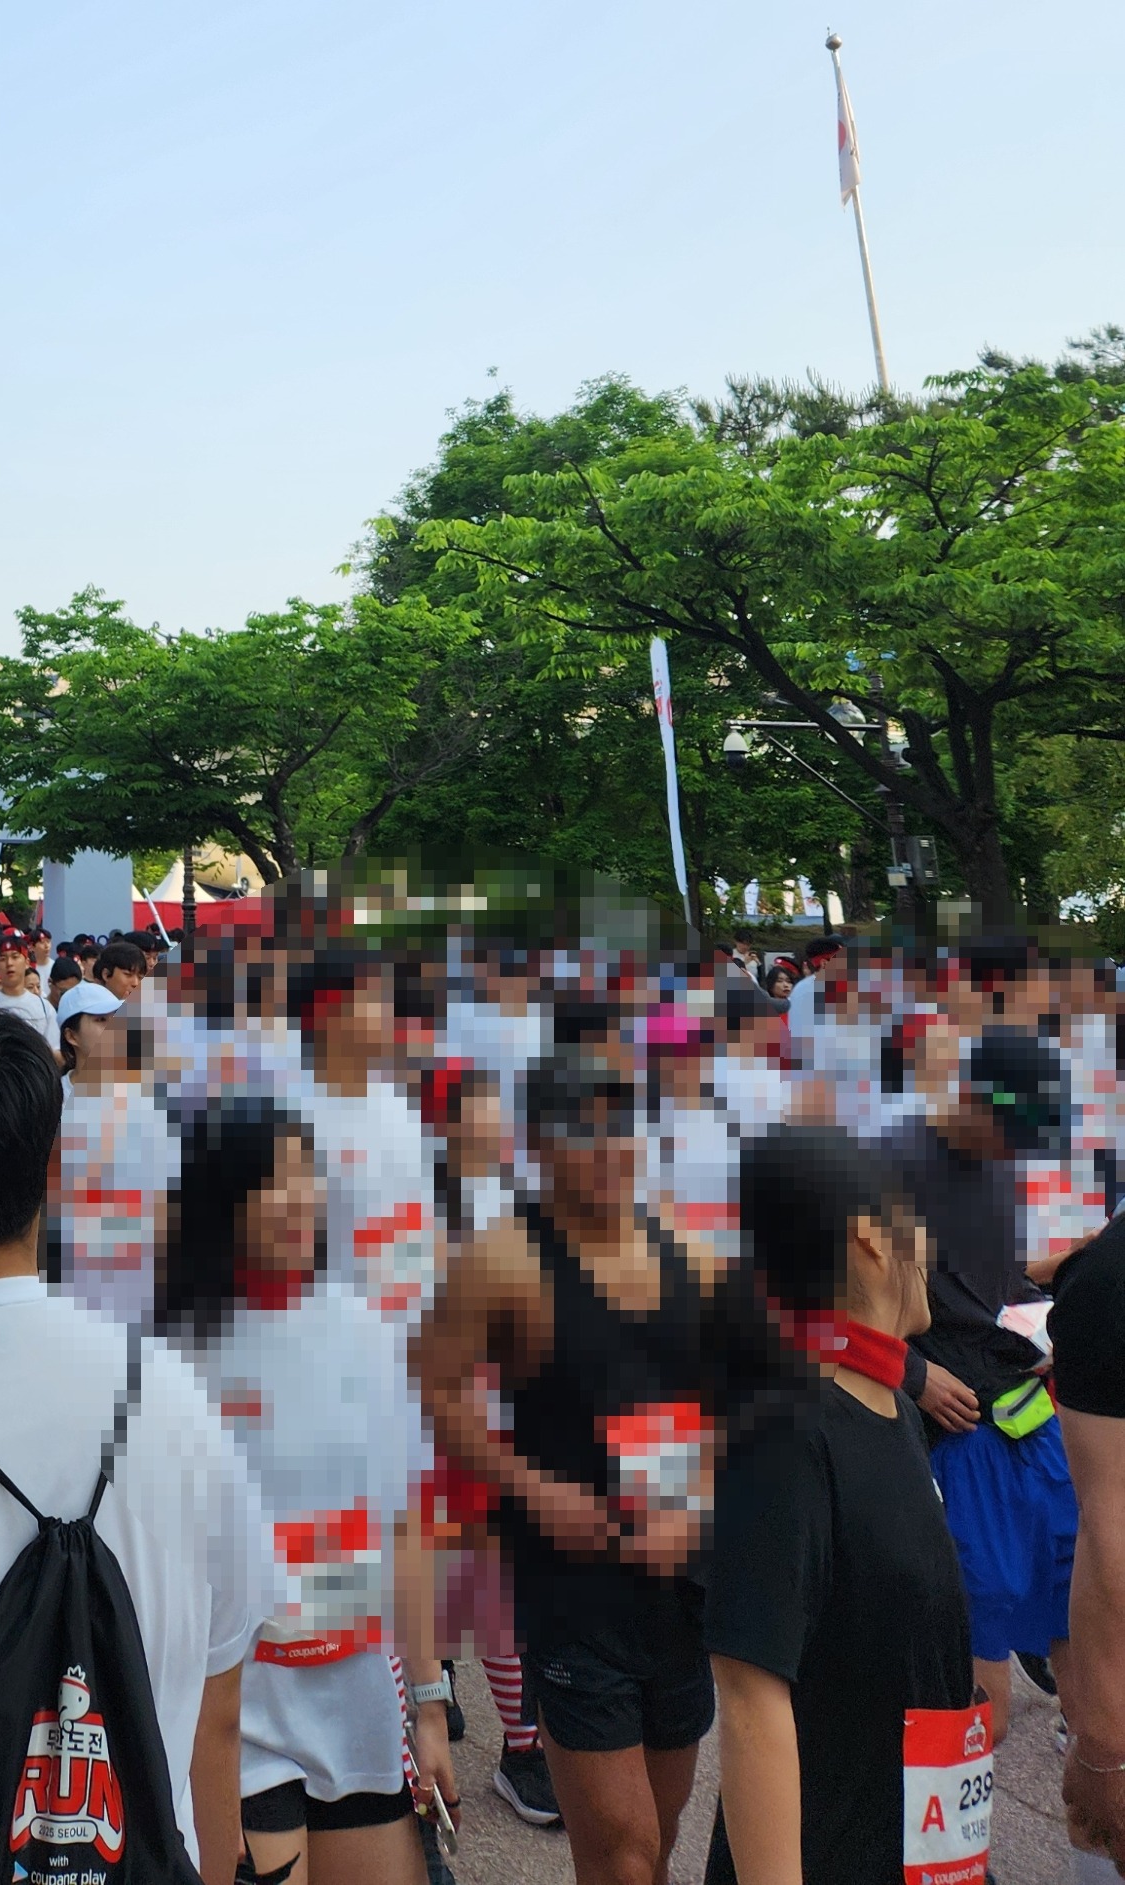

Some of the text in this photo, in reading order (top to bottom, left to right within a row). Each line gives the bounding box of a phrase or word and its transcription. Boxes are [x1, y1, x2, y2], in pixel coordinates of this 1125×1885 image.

[14, 1755, 123, 1835] RUN
[921, 1795, 946, 1834] A
[58, 1827, 88, 1838] SEOUL
[49, 1855, 69, 1867] with
[31, 1868, 106, 1885] coupang play
